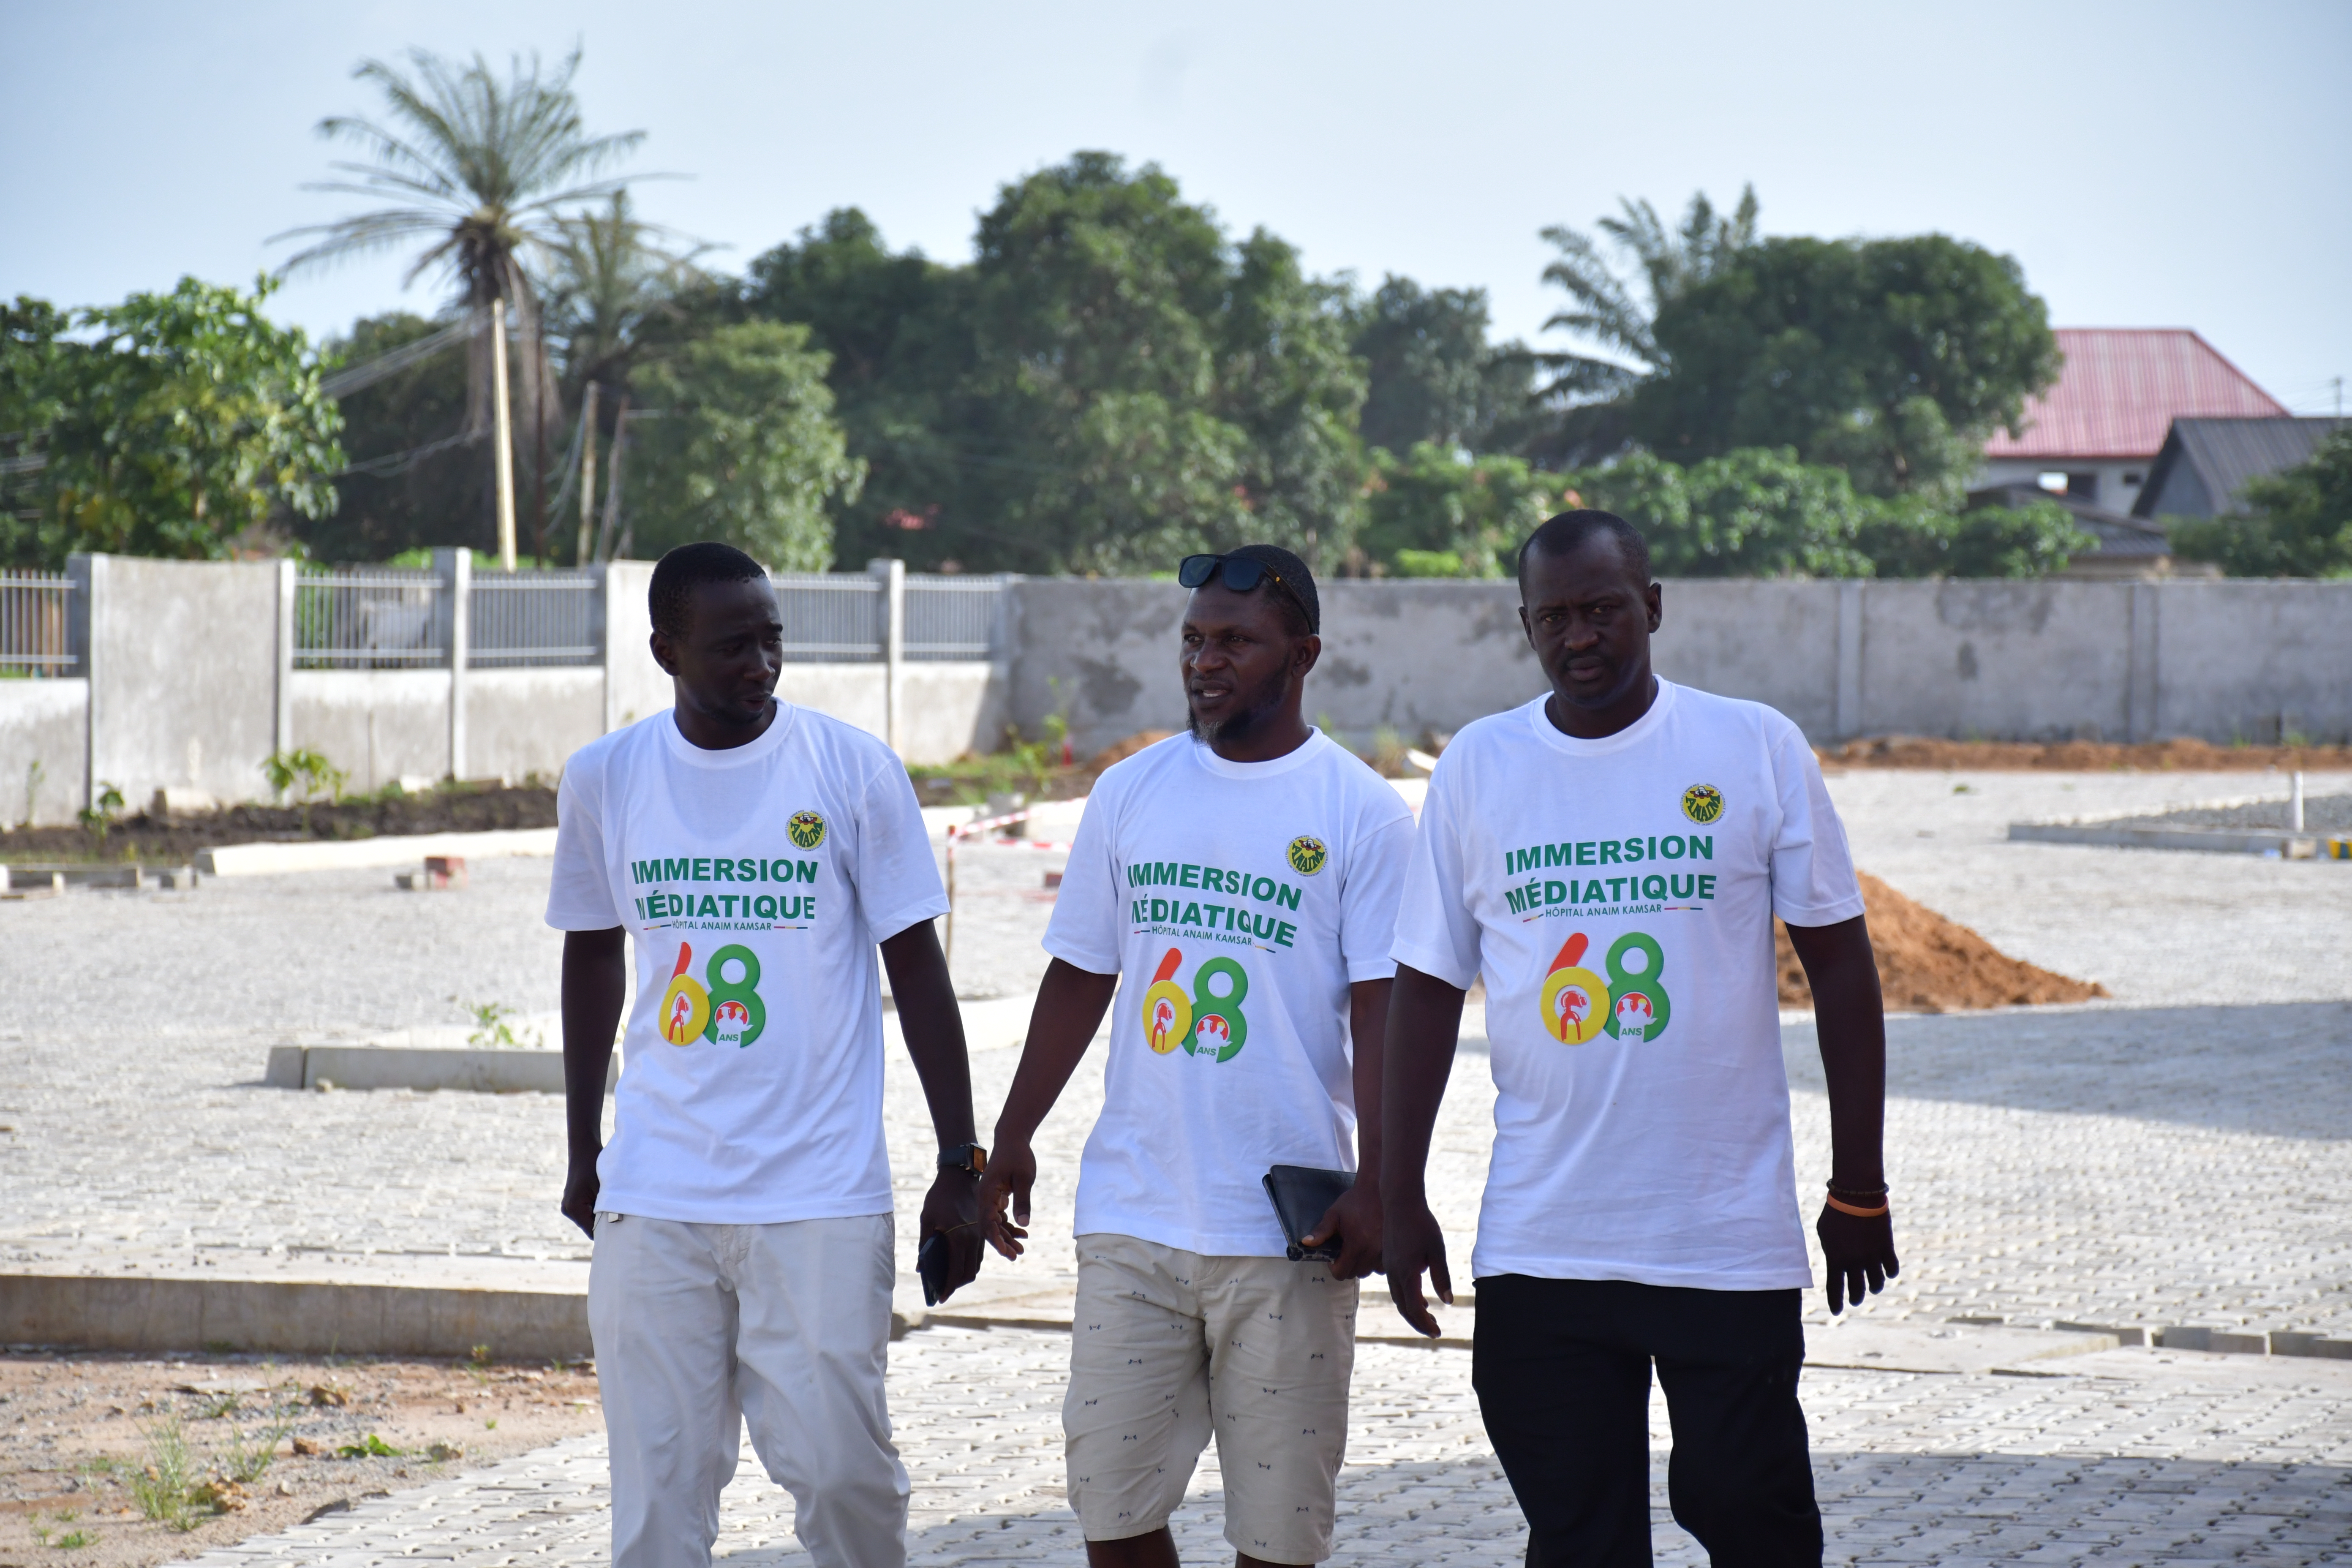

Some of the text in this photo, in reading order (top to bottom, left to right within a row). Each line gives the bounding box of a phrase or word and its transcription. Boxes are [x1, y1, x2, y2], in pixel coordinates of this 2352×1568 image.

[1685, 794, 1720, 822] ANAIM
[790, 821, 823, 848] ANAIM
[1316, 837, 1326, 848] AGENCE
[1292, 843, 1325, 872] ANAIM
[1505, 836, 1713, 876] IMMERSION
[631, 858, 818, 885] IMMERSION
[1127, 862, 1302, 912] IMMERSION
[1504, 874, 1717, 915] MÉDIATIQUE
[1546, 904, 1662, 917] HÔPITAL ANAIM KAMSAR
[672, 919, 771, 931] HÔPITAL ANAIM KAMSAR
[1152, 925, 1252, 946] HÔPITAL ANAIM KAMSAR
[658, 942, 766, 1048] 68
[1540, 932, 1671, 1045] 68
[1142, 947, 1248, 1063] 68
[719, 1034, 739, 1042] ANS
[1621, 1027, 1642, 1036] ANS
[1197, 1047, 1217, 1056] ANS
